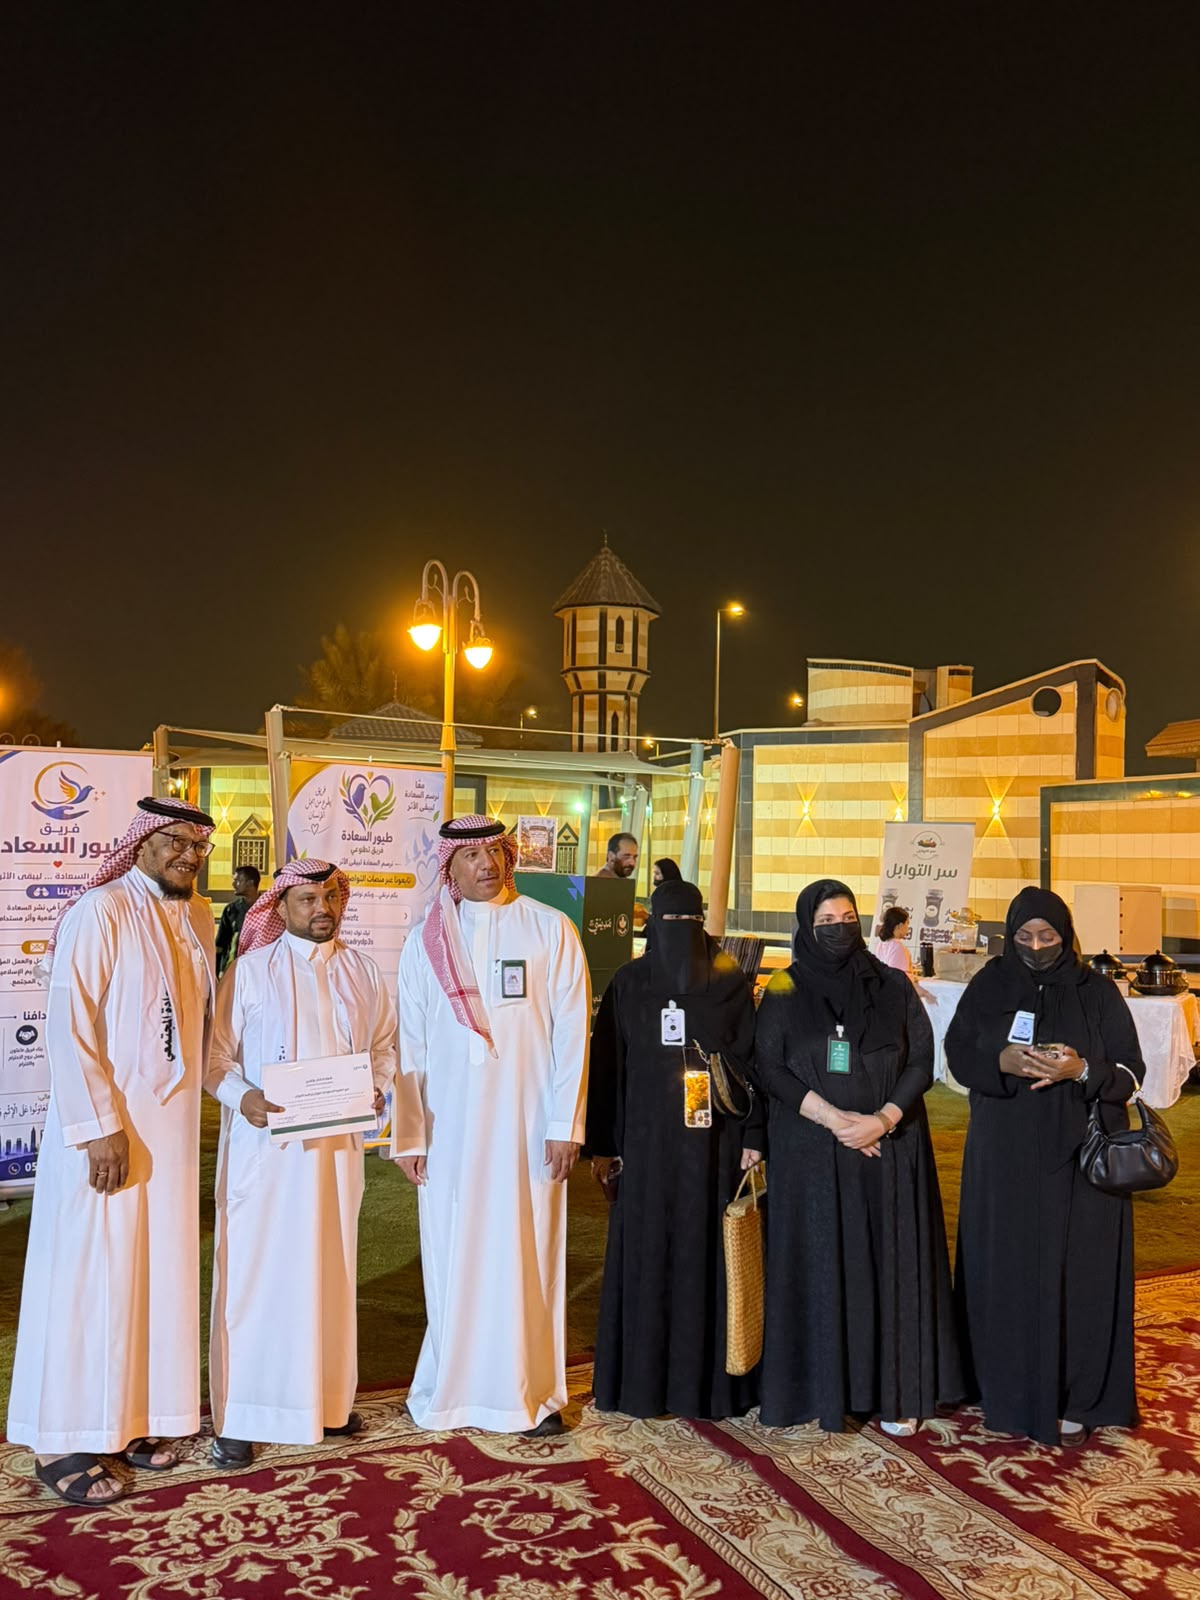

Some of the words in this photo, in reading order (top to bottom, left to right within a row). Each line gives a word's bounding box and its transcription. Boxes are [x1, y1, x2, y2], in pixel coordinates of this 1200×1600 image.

[39, 822, 80, 836] فريق
[341, 830, 372, 842] السعادة
[372, 832, 394, 845] طيور
[1, 836, 75, 853] السعاد
[886, 863, 932, 880] التوابل
[933, 868, 958, 881] سر
[0, 968, 24, 976] الإسلامي
